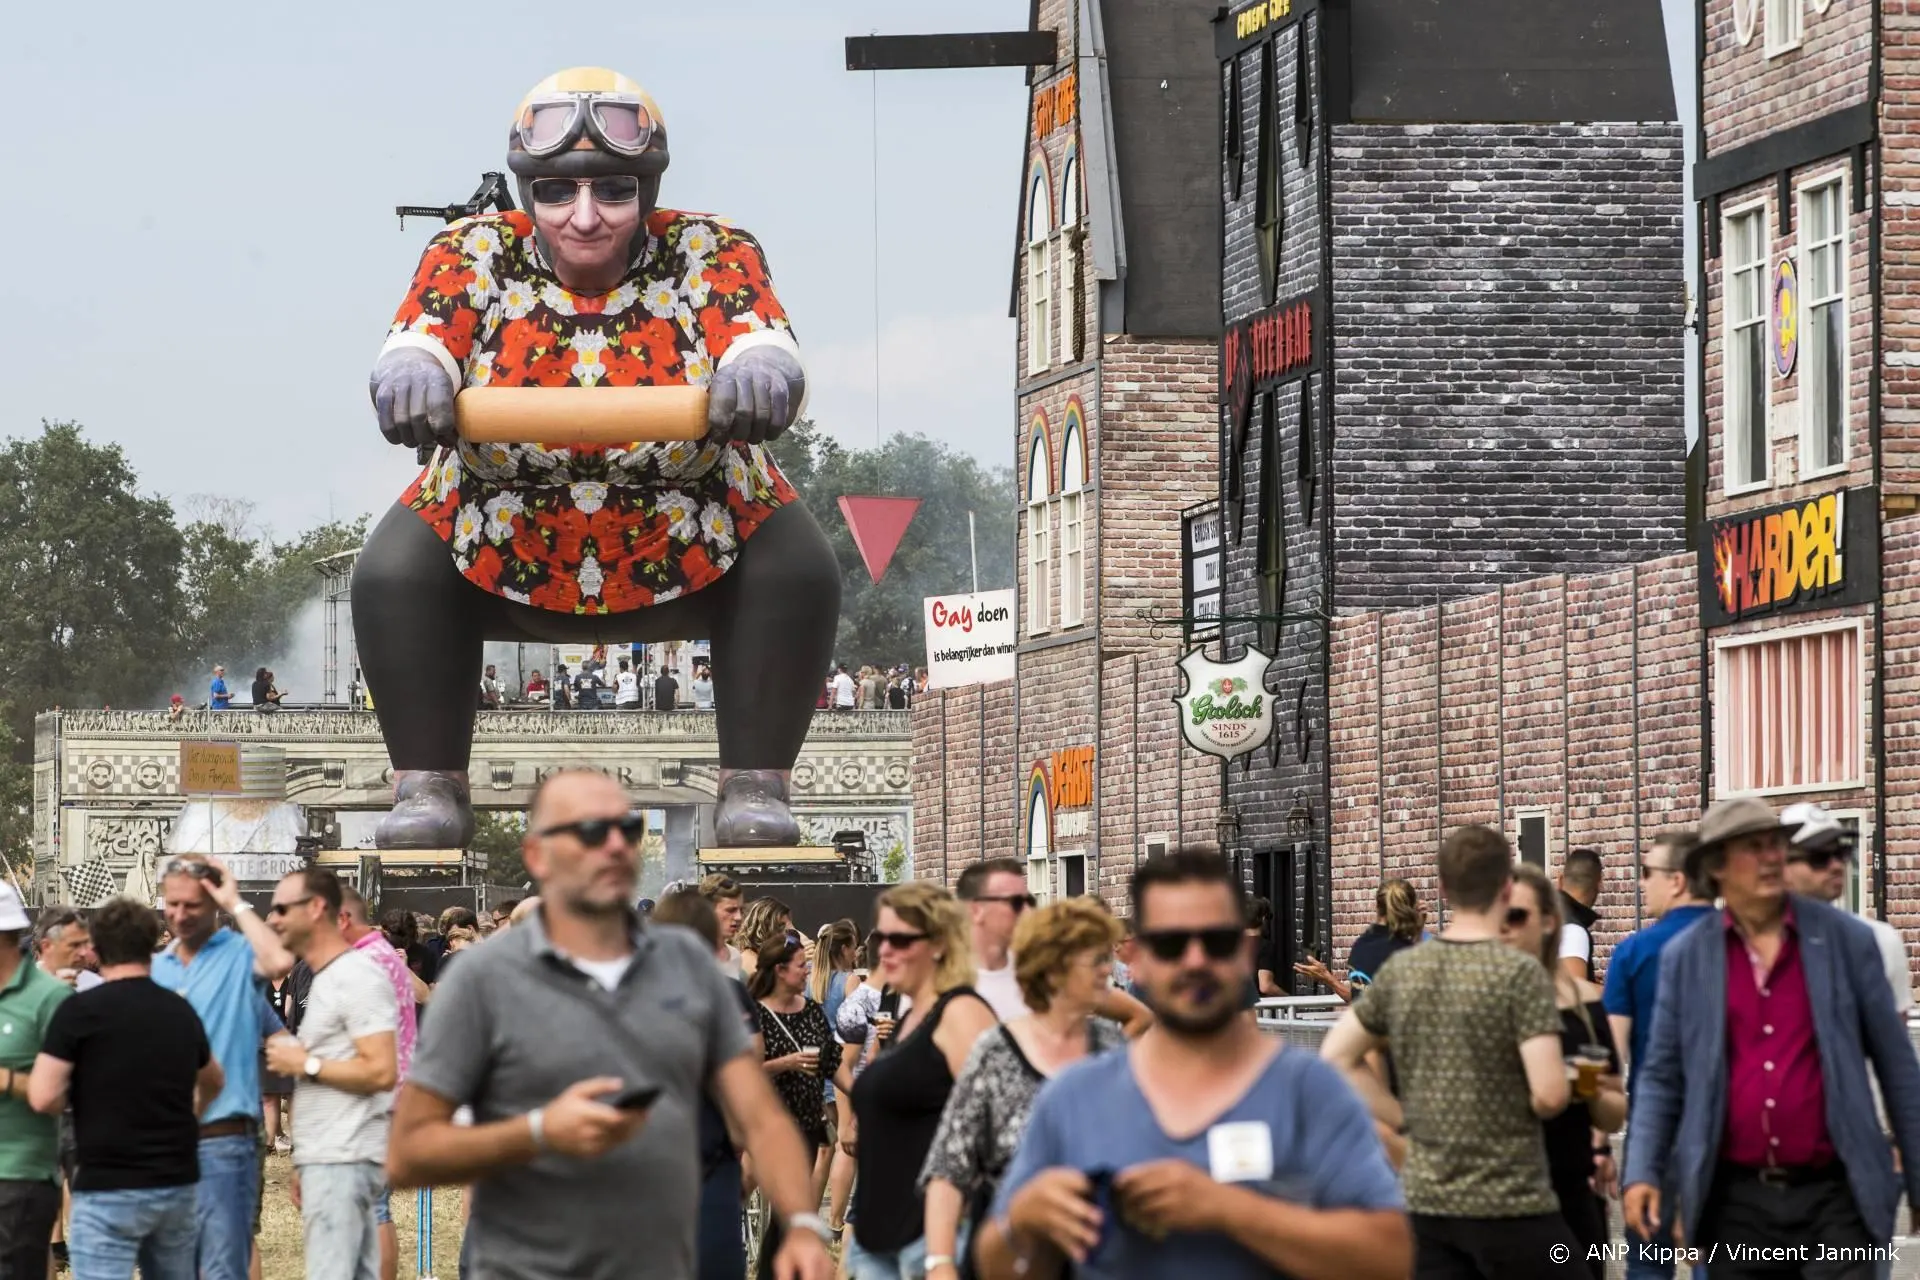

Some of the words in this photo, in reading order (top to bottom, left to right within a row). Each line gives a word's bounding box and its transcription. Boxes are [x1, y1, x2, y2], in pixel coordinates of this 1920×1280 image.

[932, 601, 973, 633] Gay
[977, 601, 1009, 622] doen
[934, 651, 940, 662] is
[941, 646, 982, 662] belangrijker
[983, 644, 995, 656] dan
[1189, 694, 1263, 725] Grolsch
[1211, 723, 1247, 731] SINDS
[1218, 731, 1240, 739] 1615
